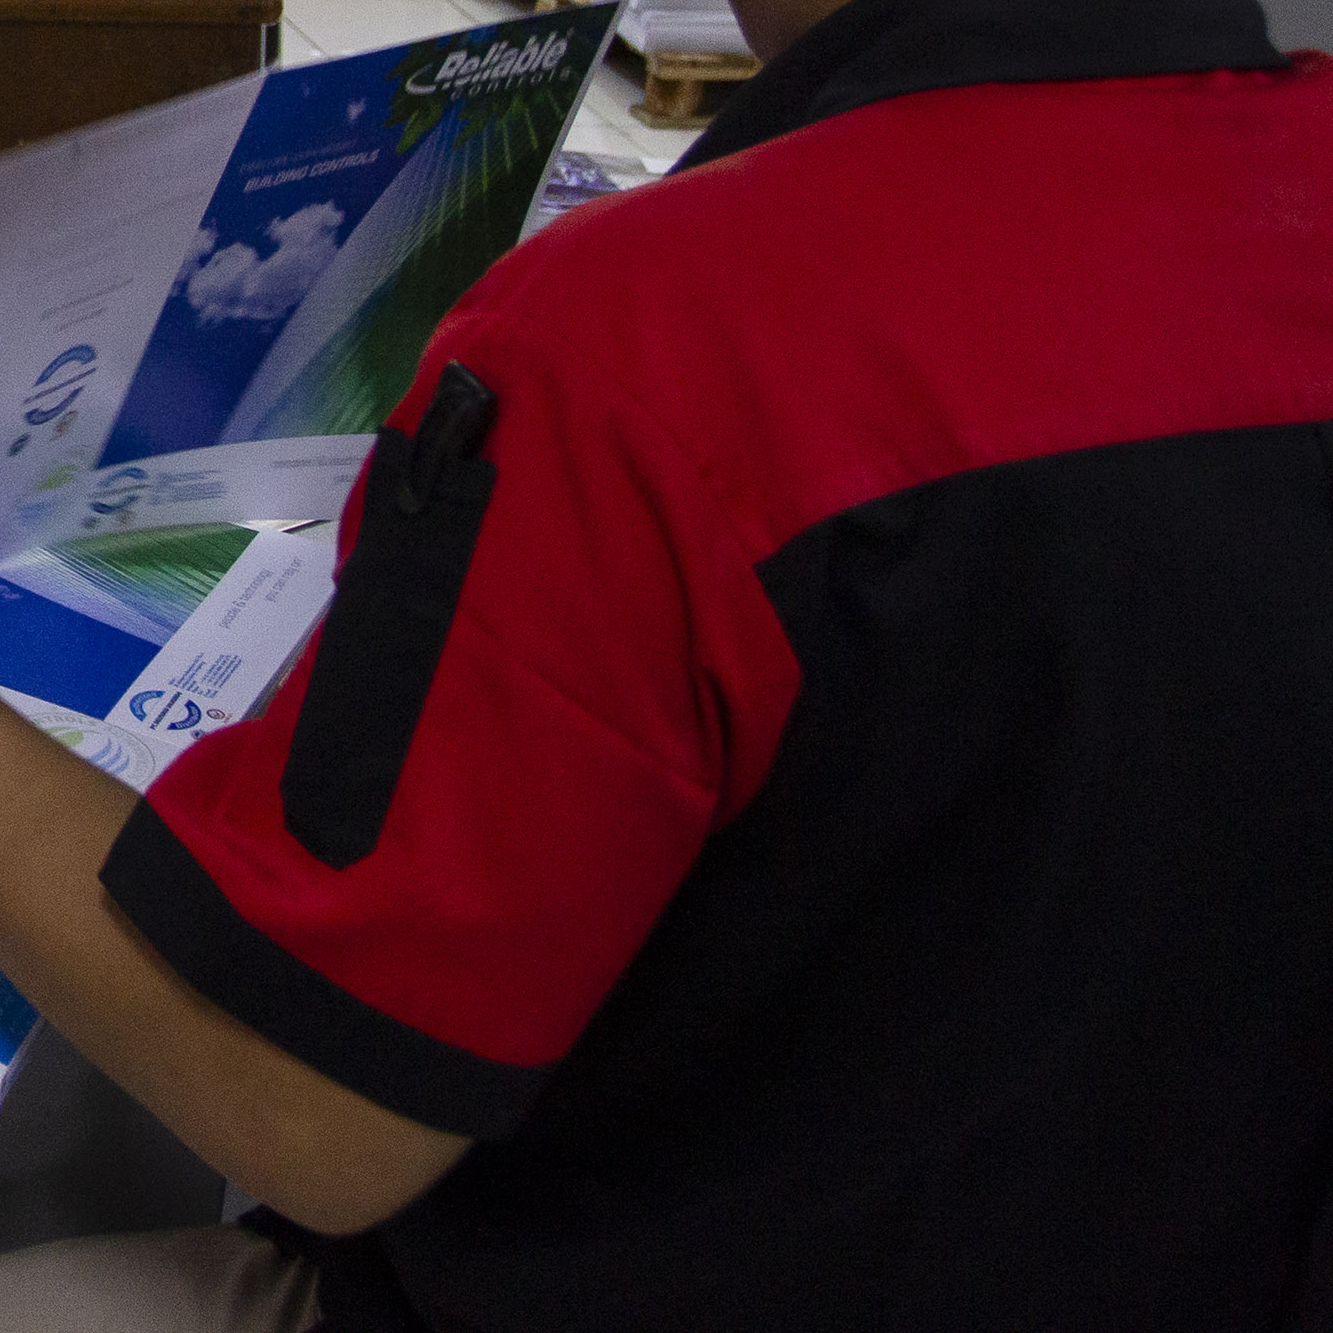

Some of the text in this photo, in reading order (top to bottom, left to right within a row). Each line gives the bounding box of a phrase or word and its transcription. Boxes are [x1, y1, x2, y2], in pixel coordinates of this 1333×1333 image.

[435, 30, 570, 91] Reliable
[242, 164, 308, 194] BUILDING
[307, 148, 381, 179] CONTROLS
